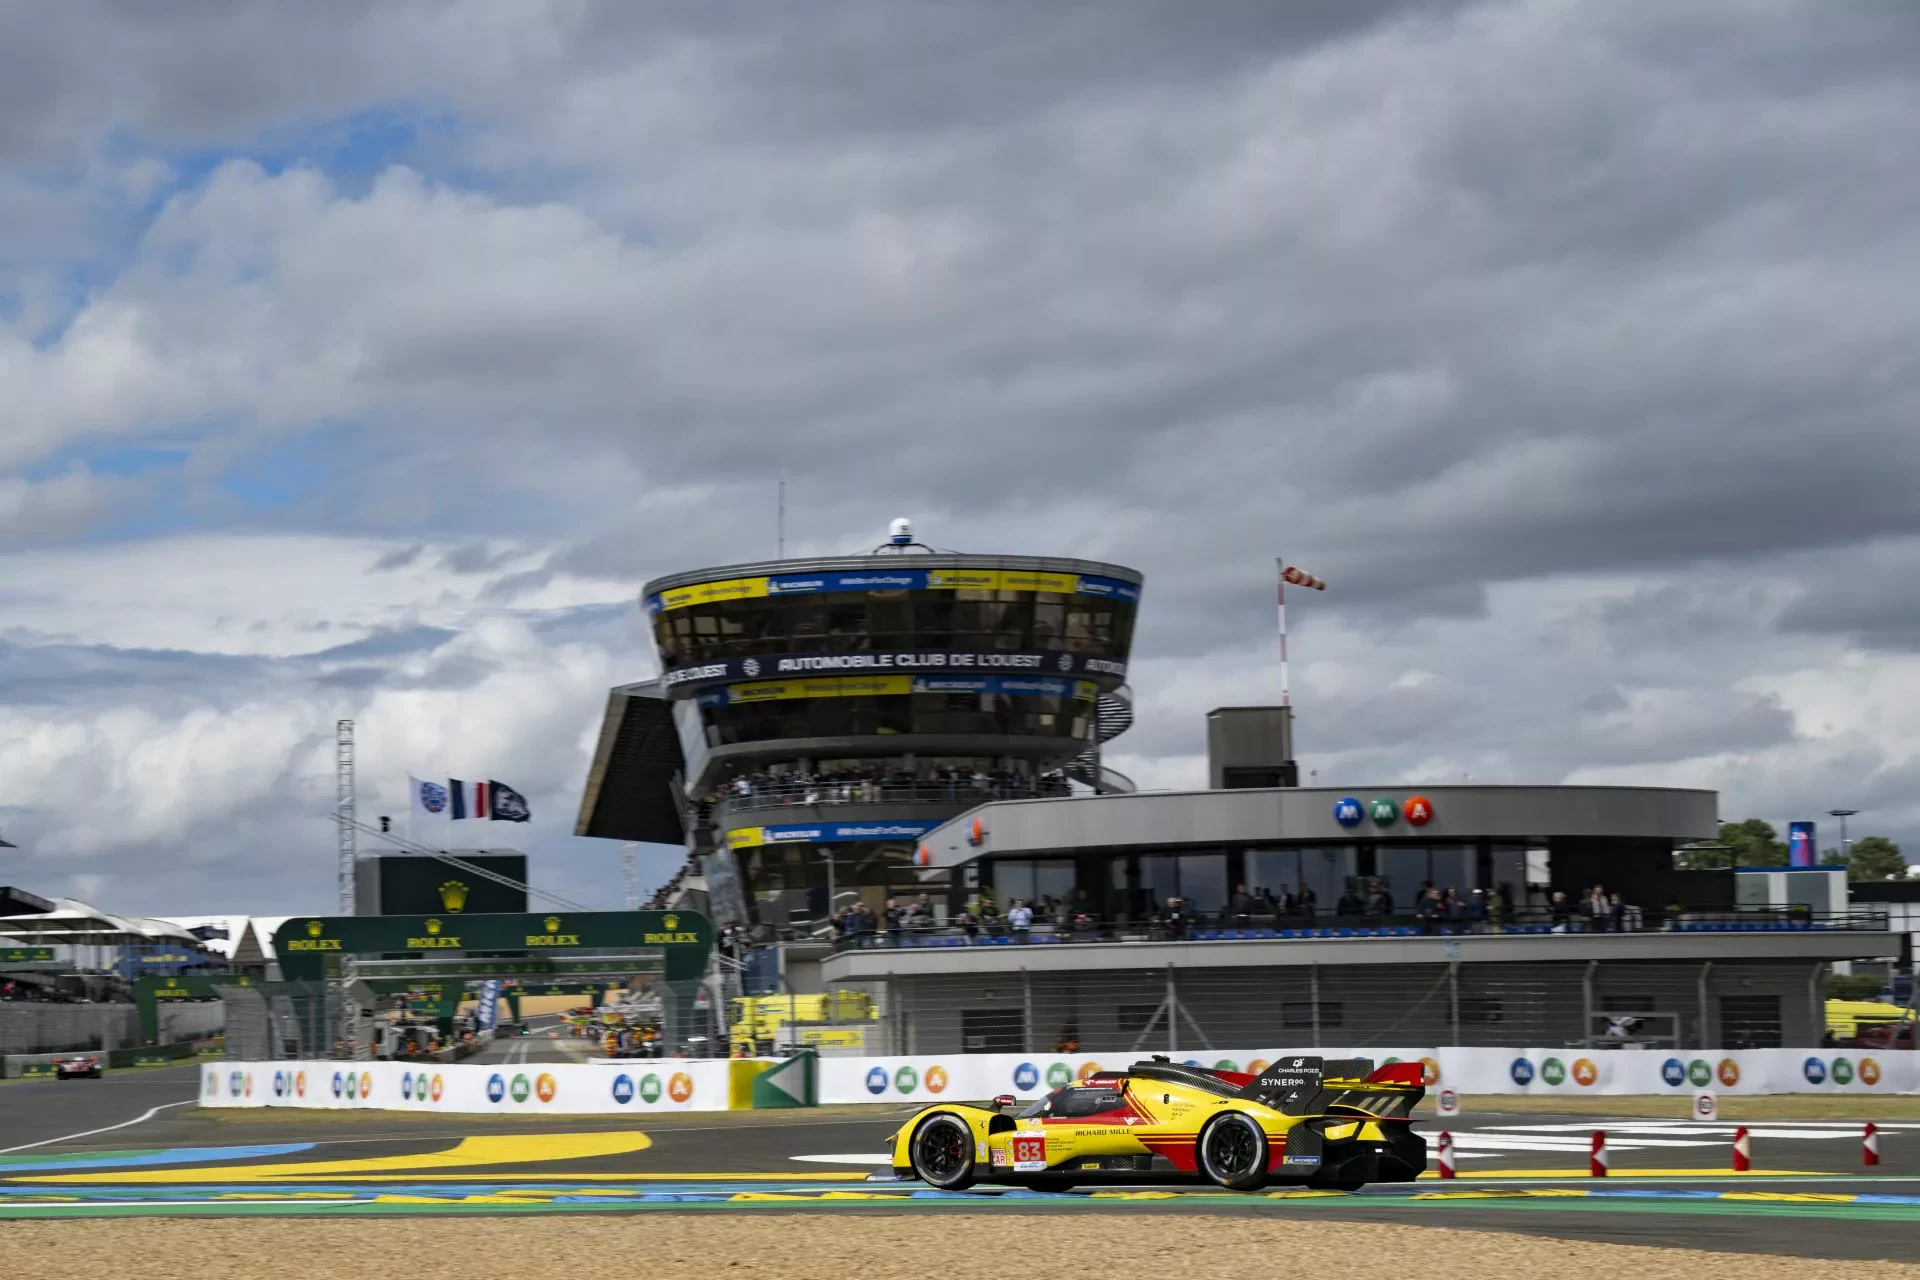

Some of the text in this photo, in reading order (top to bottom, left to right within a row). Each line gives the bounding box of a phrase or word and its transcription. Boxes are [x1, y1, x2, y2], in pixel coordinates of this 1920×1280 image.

[778, 654, 1044, 671] AUTOMOBILE CLUB DE L'OUEST
[406, 937, 462, 949] ROLEX
[525, 934, 580, 946] ROLEX
[643, 932, 698, 944] ROLEX
[288, 939, 342, 951] ROLEX
[1018, 1141, 1041, 1161] 83
